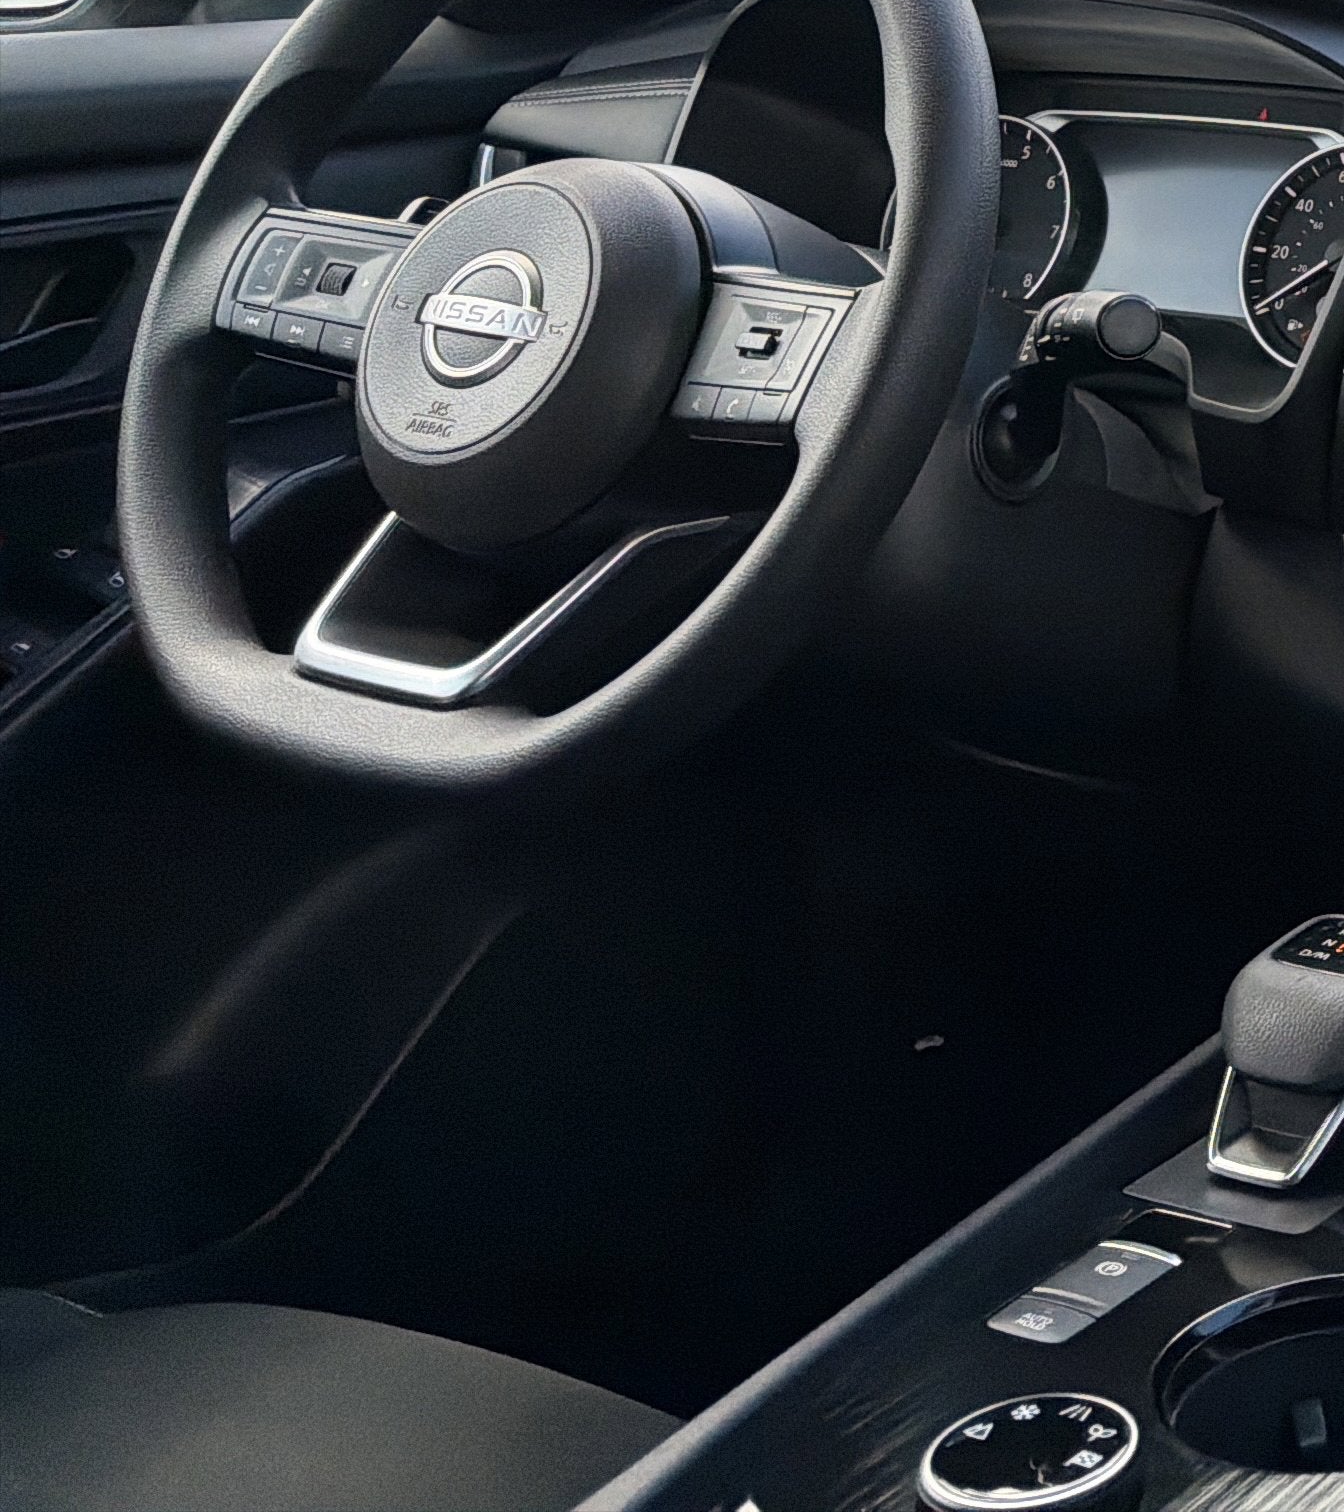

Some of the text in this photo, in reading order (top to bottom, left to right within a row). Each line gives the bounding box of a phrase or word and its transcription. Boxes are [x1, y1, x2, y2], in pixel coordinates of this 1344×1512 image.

[1021, 146, 1031, 160] 5
[1046, 175, 1056, 189] 6
[1295, 199, 1314, 212] 40
[1051, 225, 1060, 238] 7
[1271, 245, 1289, 259] 20
[1023, 273, 1032, 287] 8
[1321, 938, 1338, 947] N
[1298, 948, 1331, 961] D/M
[1015, 1317, 1046, 1331] HOLD
[1022, 1312, 1053, 1325] AUTO
